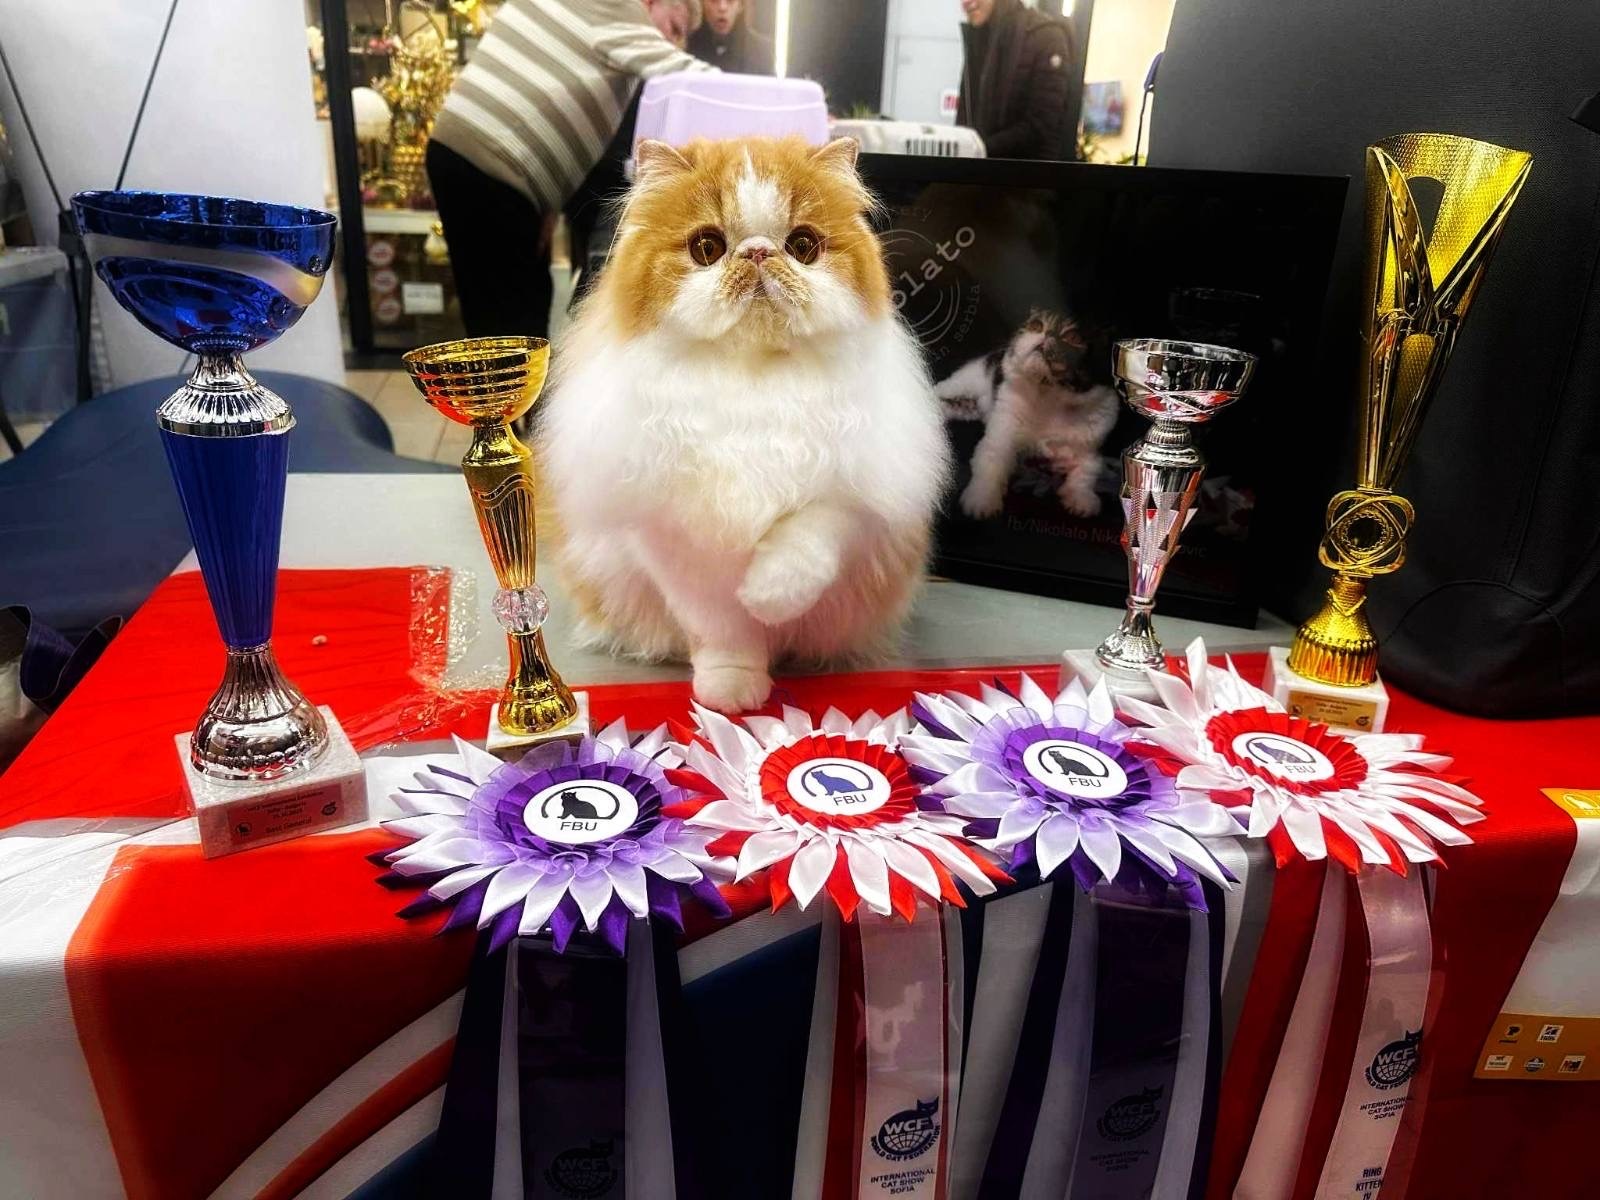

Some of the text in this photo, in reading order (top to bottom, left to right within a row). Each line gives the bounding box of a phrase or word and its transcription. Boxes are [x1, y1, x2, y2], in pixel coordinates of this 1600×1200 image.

[891, 226, 975, 310] olato
[1284, 765, 1316, 774] FBU
[1069, 777, 1102, 788] FBU
[833, 793, 868, 806] FBU
[560, 821, 598, 831] FBU
[1377, 1047, 1415, 1066] WCF
[1109, 1104, 1153, 1117] WCF
[1374, 1111, 1396, 1120] SOFIA
[884, 1117, 930, 1135] WCF
[558, 1157, 608, 1171] WCF
[886, 1154, 900, 1162] CAT
[870, 1168, 937, 1184] INTERNATIONAL
[1362, 1167, 1383, 1178] RING
[881, 1176, 925, 1189] CAT SHOW
[889, 1186, 915, 1195] SOFIA
